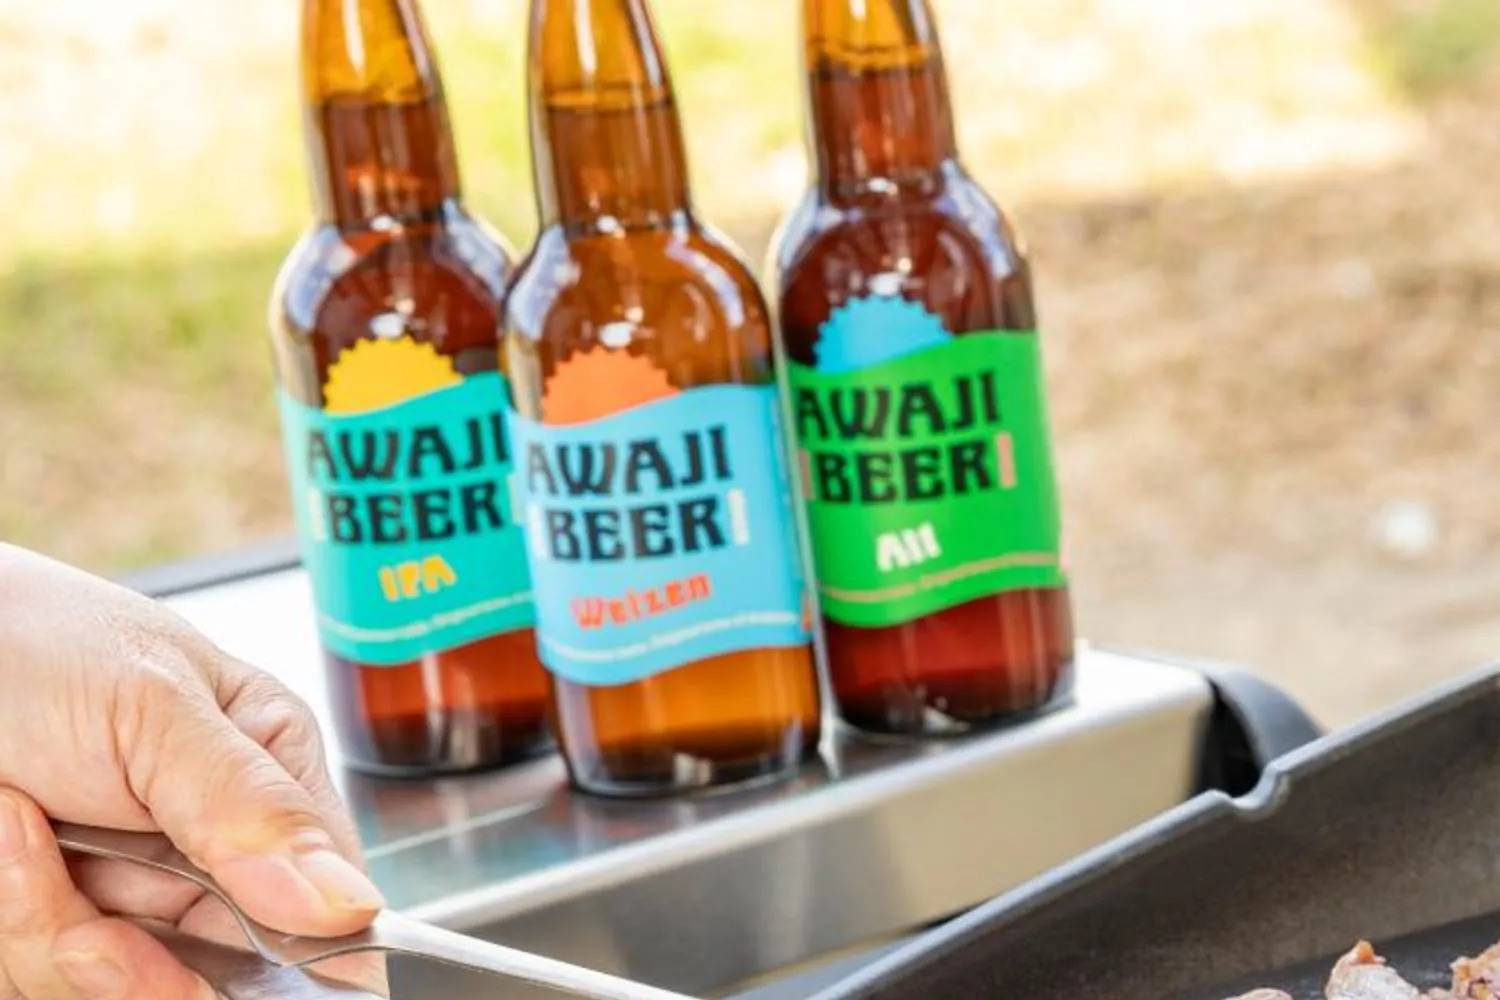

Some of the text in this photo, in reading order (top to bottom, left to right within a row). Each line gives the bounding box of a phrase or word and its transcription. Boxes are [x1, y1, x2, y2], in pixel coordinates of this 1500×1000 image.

[799, 371, 998, 440] AWAJI
[307, 410, 508, 482] AWAJI
[527, 424, 732, 496] AWAJI
[816, 441, 991, 504] BEER
[327, 482, 503, 545] BEER
[546, 498, 725, 562] BEER
[378, 555, 455, 601] IPA
